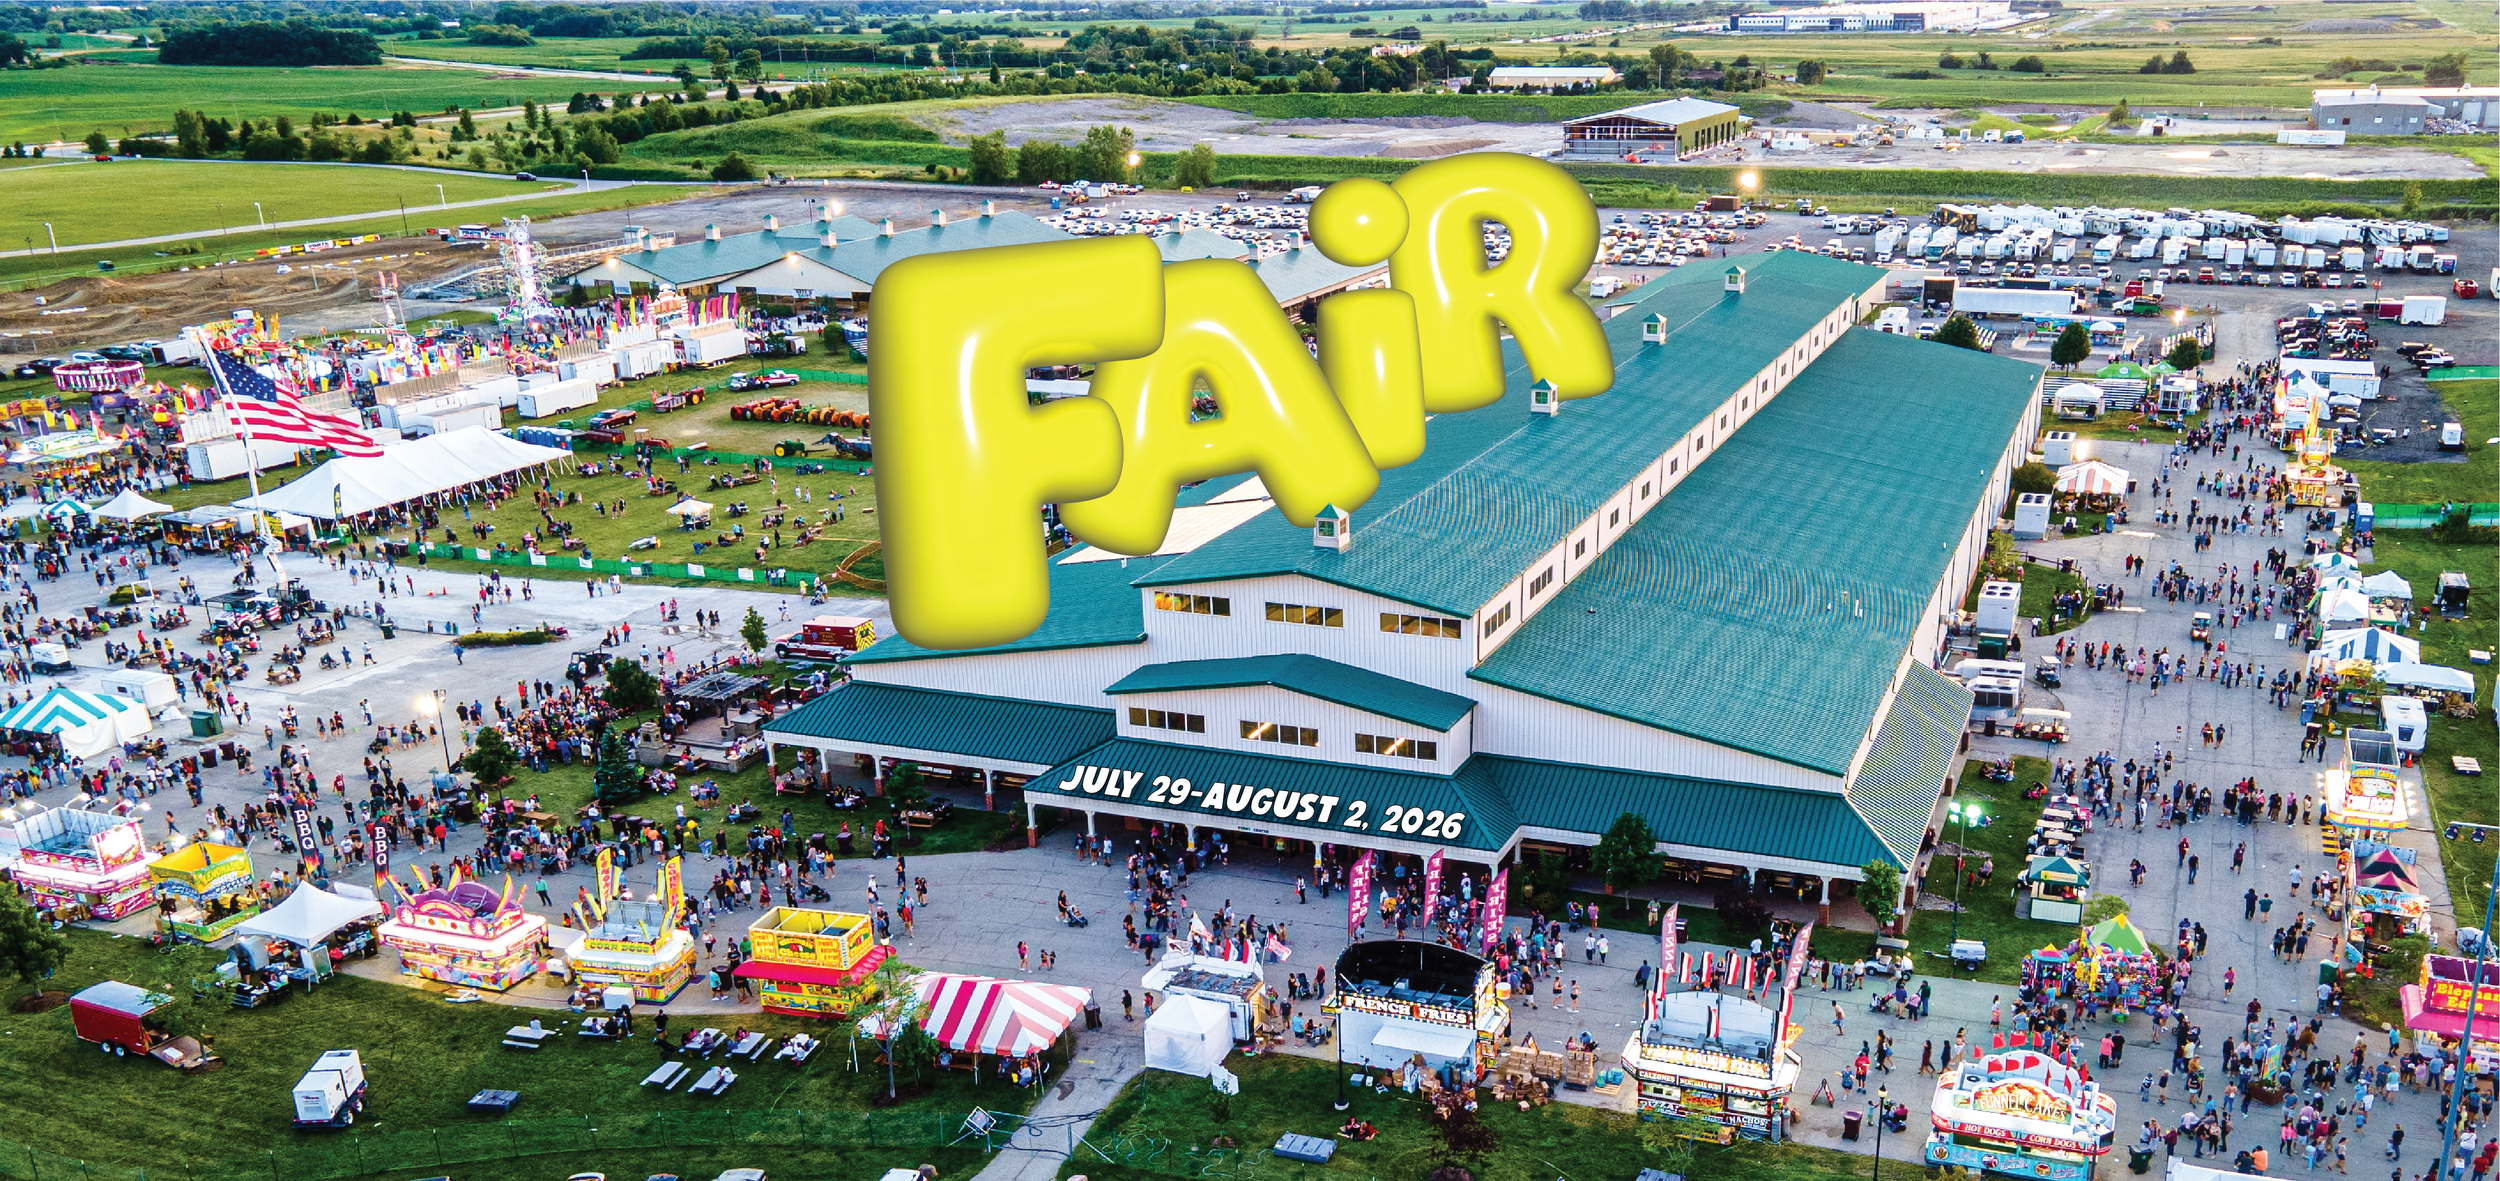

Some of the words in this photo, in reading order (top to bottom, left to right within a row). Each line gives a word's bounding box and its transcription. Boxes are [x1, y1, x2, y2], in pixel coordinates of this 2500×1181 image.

[294, 809, 315, 850] BBQ
[374, 826, 387, 866] BBQ
[590, 942, 618, 951] CORN
[621, 944, 650, 953] DOGS
[1345, 996, 1411, 1016] FRENCH
[1419, 1007, 1467, 1024] FRIES
[2447, 996, 2484, 1012] Eas
[1686, 1051, 1728, 1069] DOUGH
[1639, 1071, 1676, 1083] CALZONES
[1727, 1086, 1763, 1098] PASTA
[1979, 1093, 2020, 1110] FUNNEL
[2024, 1096, 2067, 1122] CAKES
[1965, 1124, 1981, 1134] HOT
[1983, 1126, 2006, 1137] DOGS
[2029, 1134, 2052, 1146] CORN
[2053, 1137, 2077, 1149] DOGS
